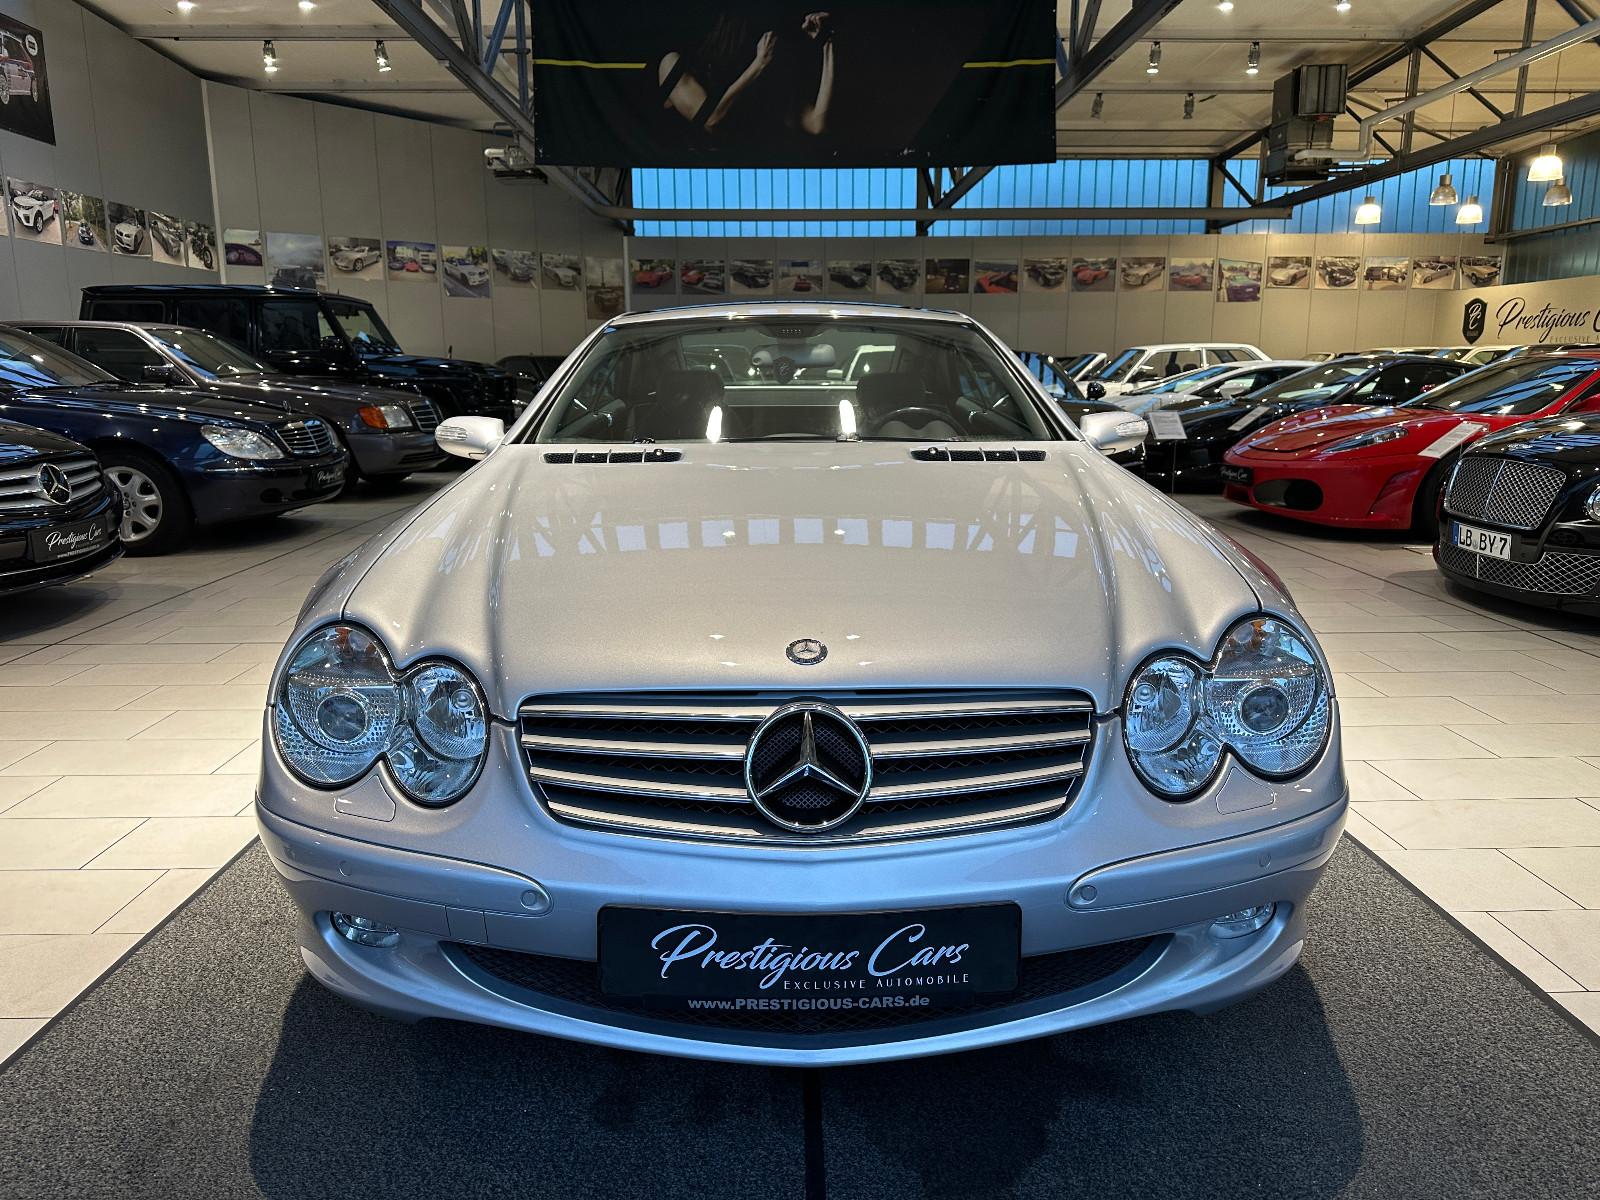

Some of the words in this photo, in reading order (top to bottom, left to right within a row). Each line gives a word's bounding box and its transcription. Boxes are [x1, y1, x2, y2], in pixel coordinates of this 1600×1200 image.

[1496, 297, 1591, 344] Prestigious
[1459, 526, 1473, 547] LB
[1479, 532, 1497, 553] BY
[1499, 536, 1508, 556] 7
[651, 923, 860, 990] Prestigious
[867, 923, 970, 977] Cars
[783, 979, 867, 990] EXCLUSIVE
[876, 973, 970, 988] AUTOMOBILE
[687, 994, 931, 1010] www.PRESTIGIOUS-CARS.de
